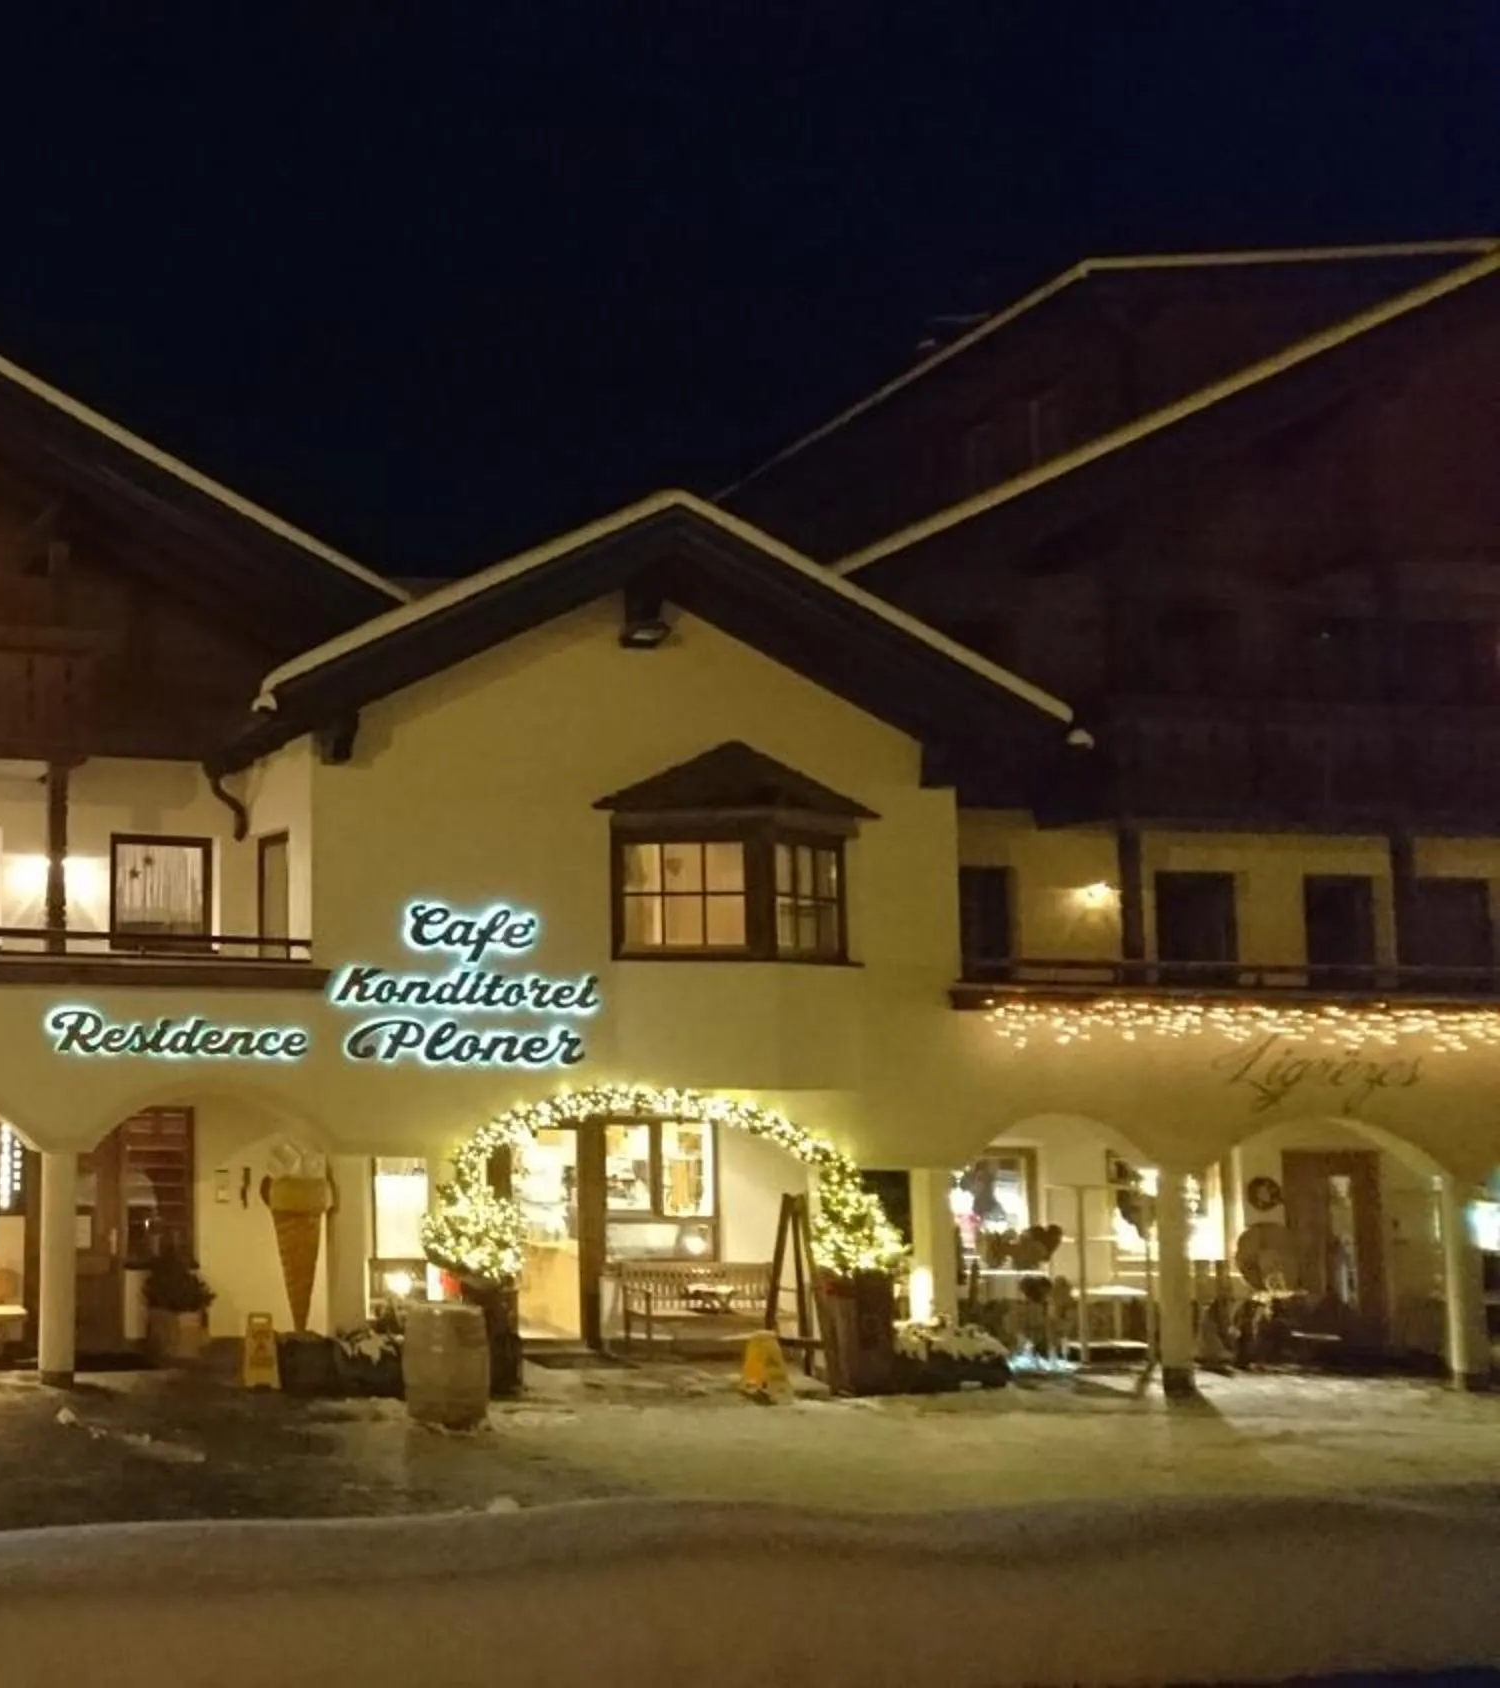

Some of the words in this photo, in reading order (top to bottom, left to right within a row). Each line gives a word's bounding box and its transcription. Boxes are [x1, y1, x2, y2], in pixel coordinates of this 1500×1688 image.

[334, 967, 599, 1008] Konditorei
[51, 1011, 309, 1056] Residence
[347, 1019, 586, 1064] Ploner
